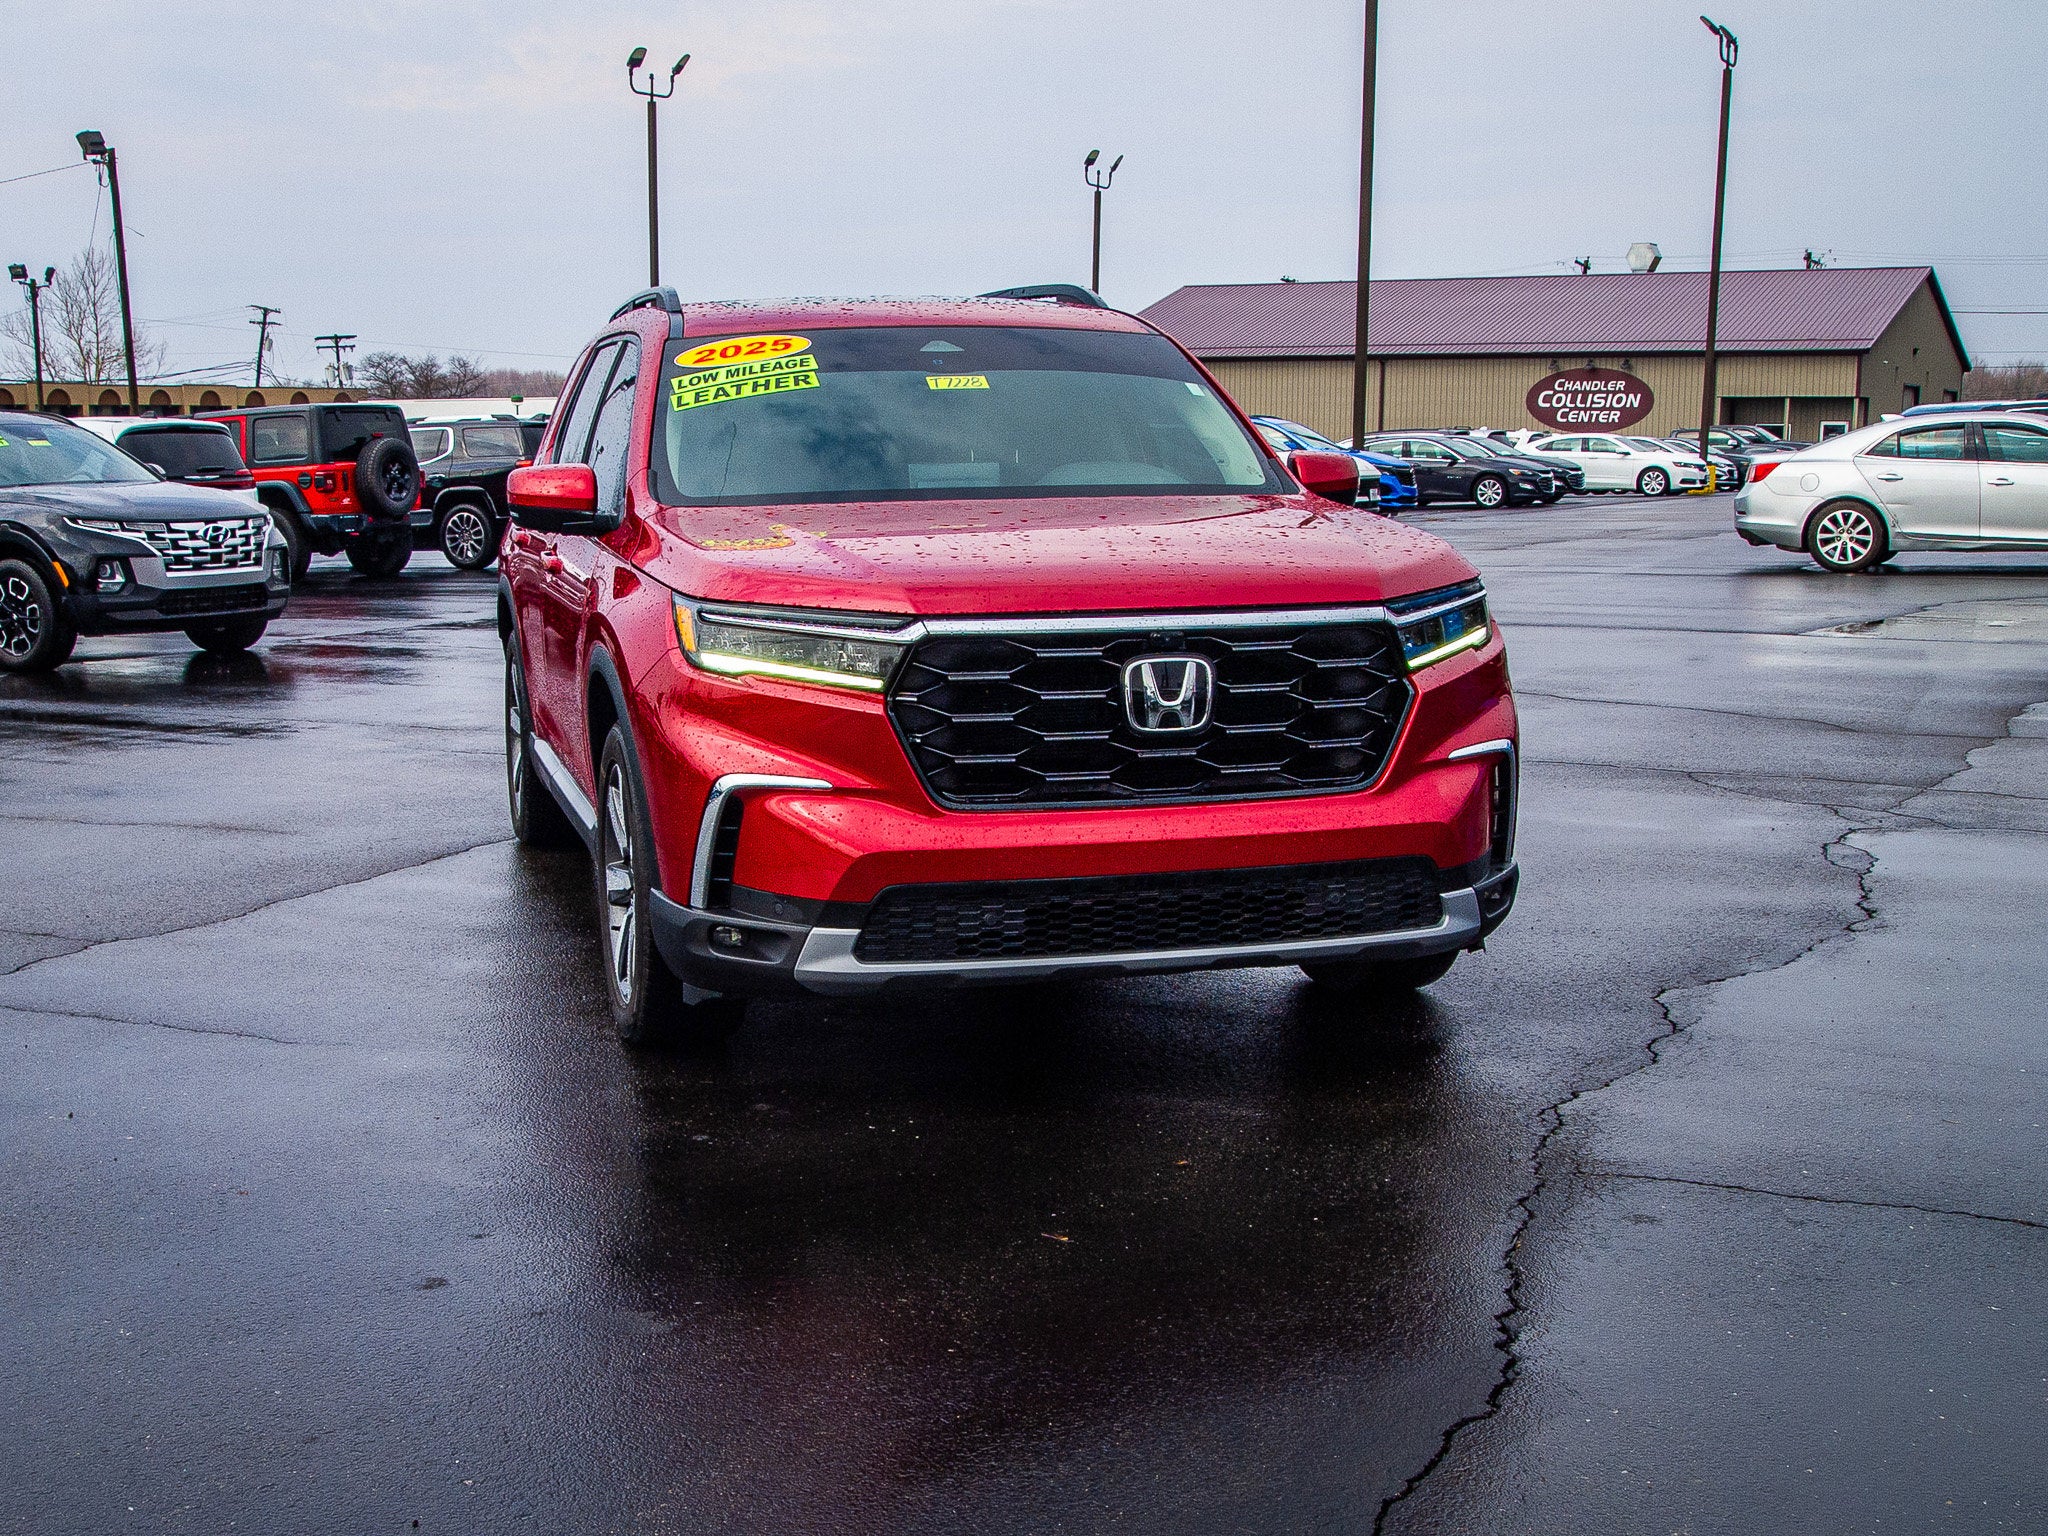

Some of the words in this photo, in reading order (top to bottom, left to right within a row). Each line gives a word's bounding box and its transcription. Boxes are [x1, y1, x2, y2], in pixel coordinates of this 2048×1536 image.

[692, 338, 792, 364] 2025
[677, 371, 719, 390] LOW
[725, 357, 811, 379] MILEAGE
[676, 374, 812, 408] LEATHER
[1554, 379, 1626, 391] CHANDLER
[1537, 390, 1641, 408] COLLISION
[1556, 408, 1621, 423] CENTER
